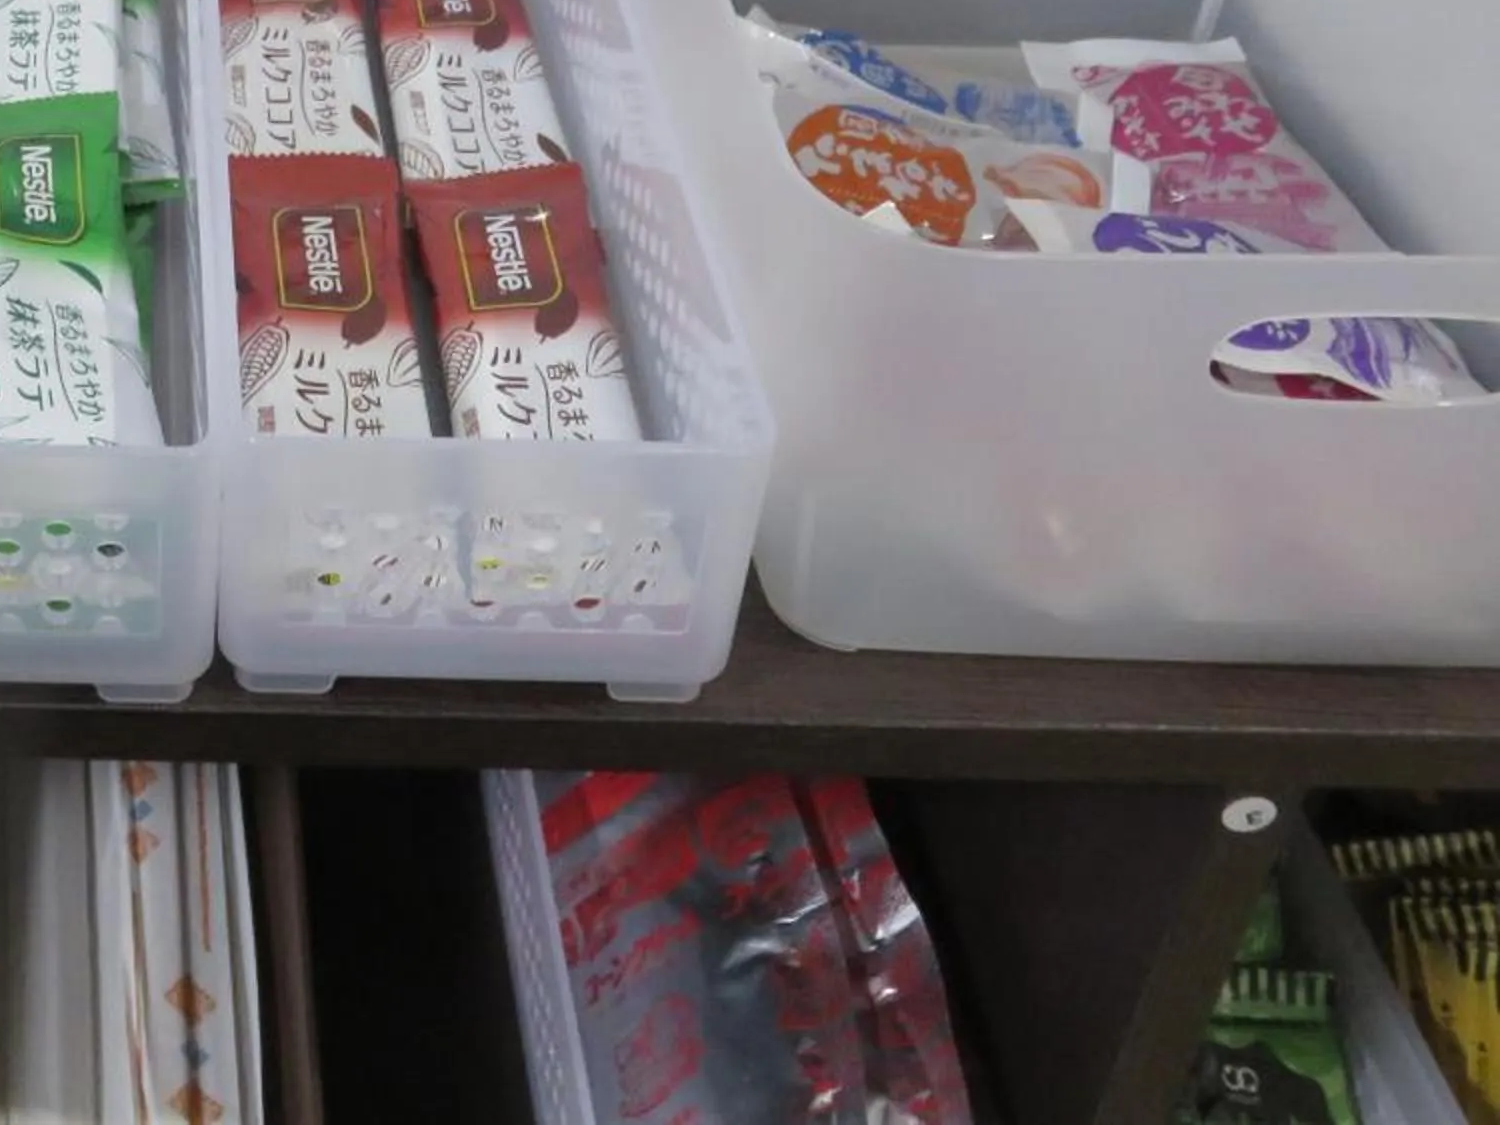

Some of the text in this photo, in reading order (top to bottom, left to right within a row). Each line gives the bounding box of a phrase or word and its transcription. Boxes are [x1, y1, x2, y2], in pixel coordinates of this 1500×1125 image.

[5, 9, 42, 93] 抹茶ラテ
[260, 26, 297, 151] ミルクココア
[4, 296, 55, 412] 抹茶ラテ
[53, 301, 106, 424] 香るまろやか
[293, 348, 335, 435] ミルク
[490, 346, 538, 441] ミルク
[348, 367, 385, 437] 香るま
[546, 359, 595, 441] 香るま
